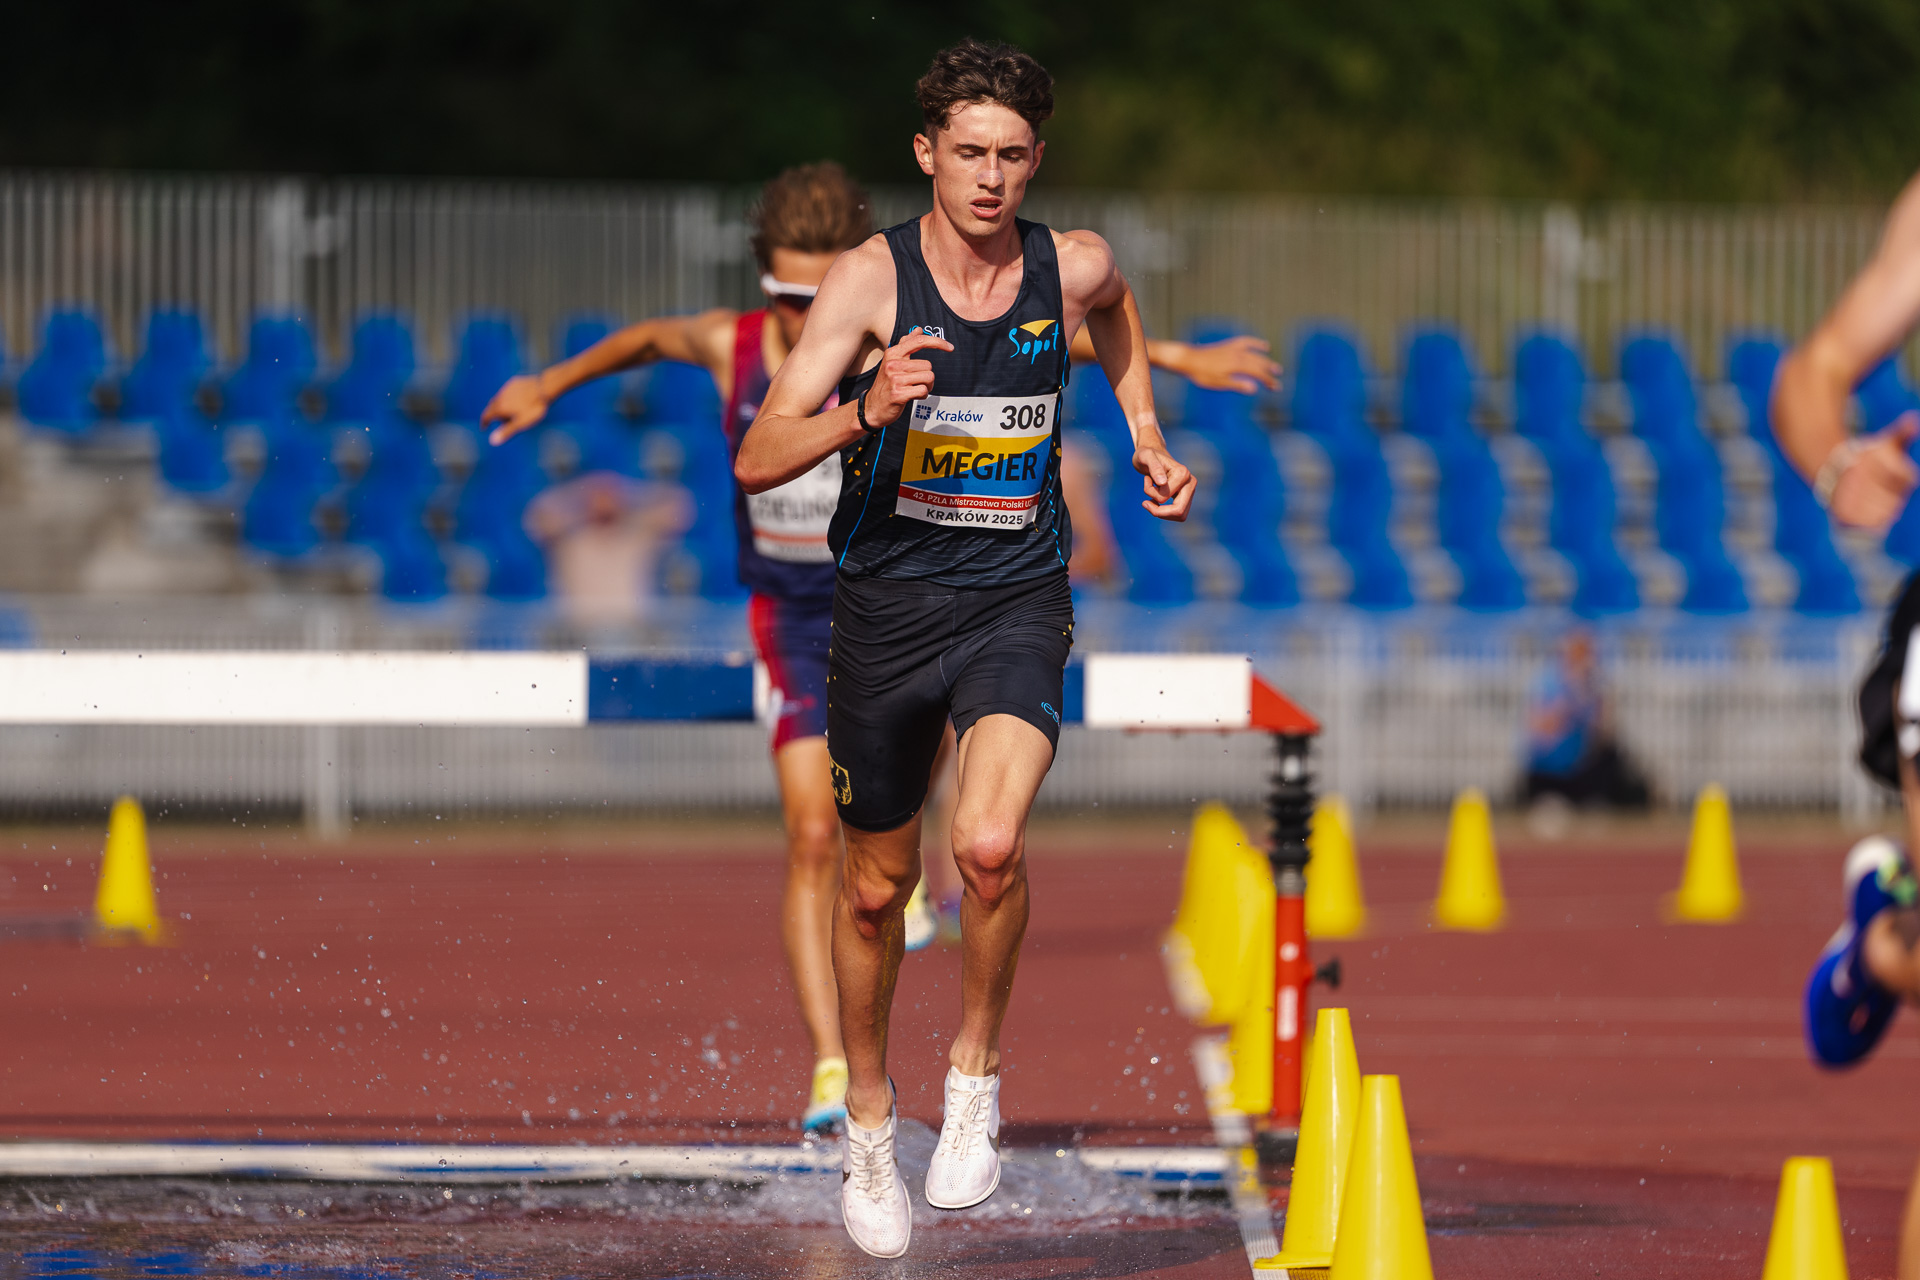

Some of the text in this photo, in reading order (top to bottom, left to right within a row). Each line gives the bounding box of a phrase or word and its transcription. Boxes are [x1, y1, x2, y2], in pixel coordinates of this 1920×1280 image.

[1008, 322, 1060, 365] Sopot
[936, 409, 984, 422] Kraków
[1000, 403, 1047, 430] 308
[921, 447, 1037, 481] MEGIER
[912, 491, 926, 501] 42.
[927, 495, 947, 505] PZLA
[949, 497, 1000, 508] Mistrzostwa
[1001, 500, 1024, 509] Polski
[926, 508, 1023, 525] KRAKÓW 2025
